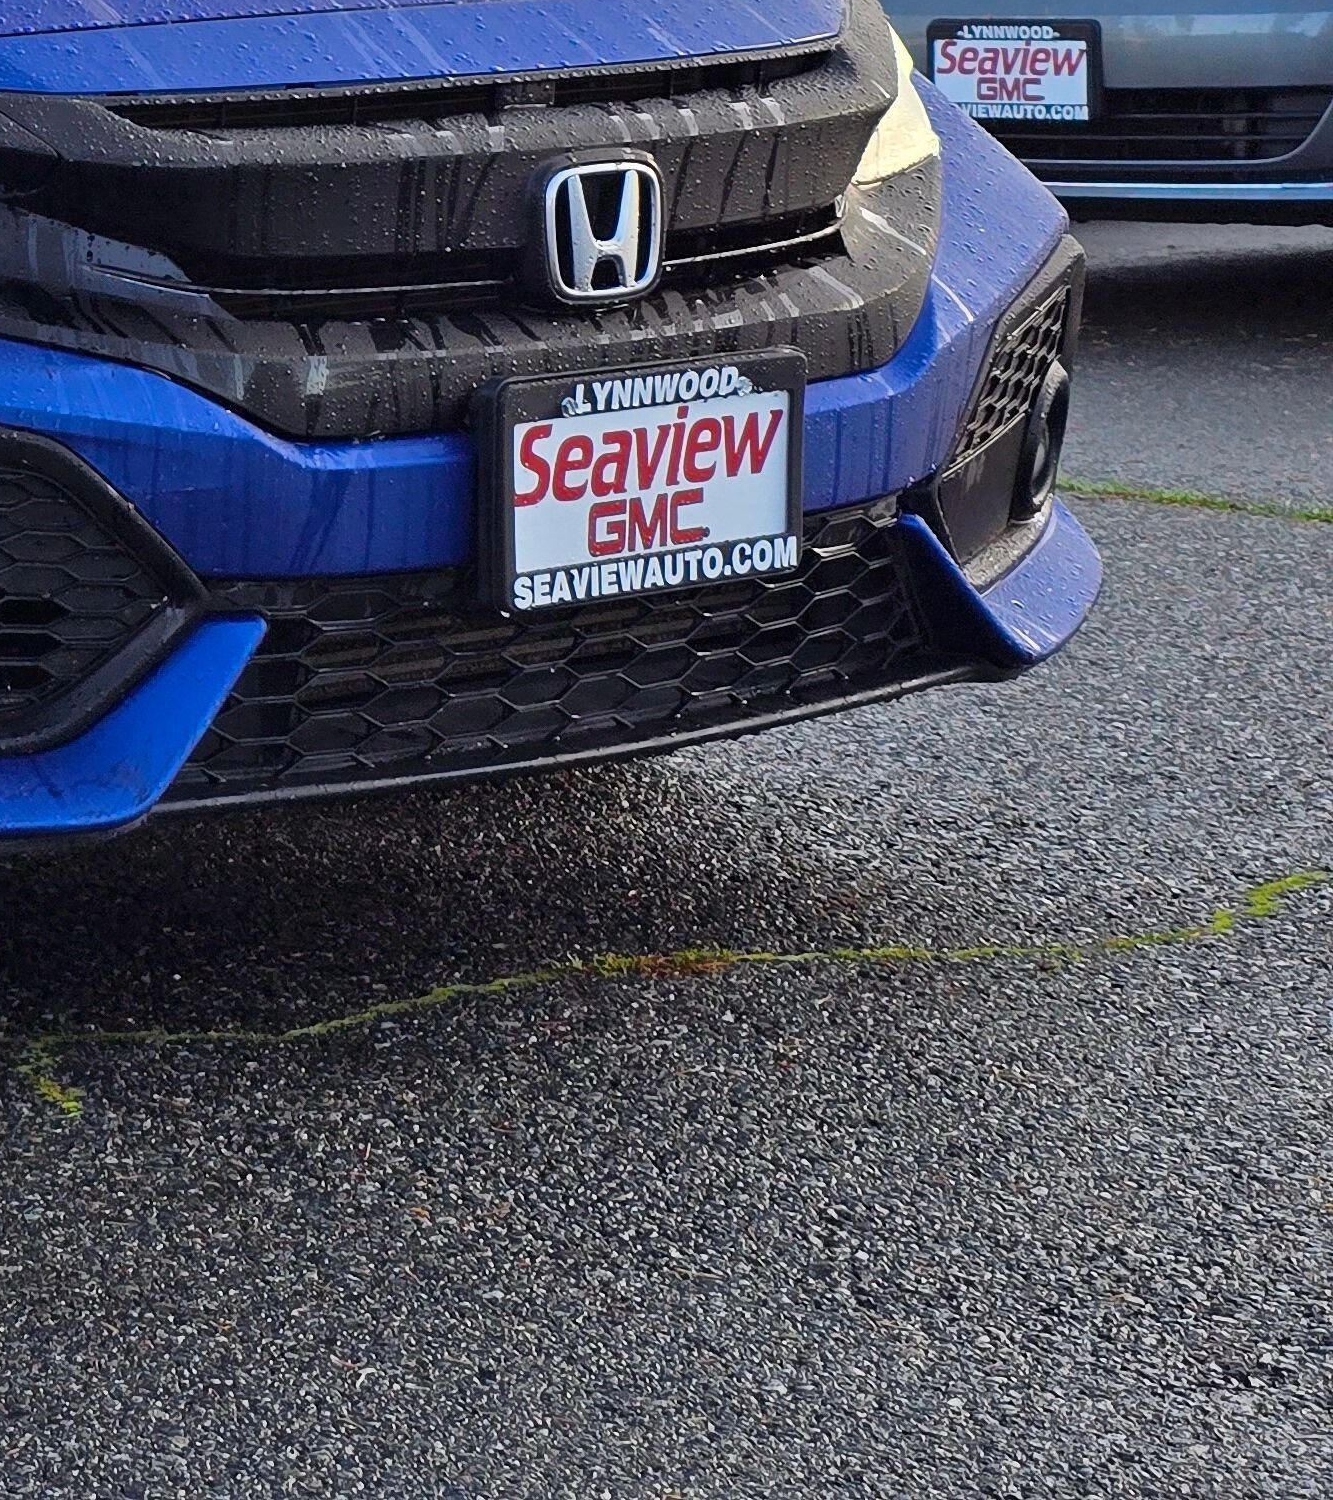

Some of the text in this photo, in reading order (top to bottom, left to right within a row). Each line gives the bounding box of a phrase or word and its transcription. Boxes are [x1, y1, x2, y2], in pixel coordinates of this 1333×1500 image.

[962, 25, 1054, 39] LYNNWOOD
[936, 39, 1088, 76] Seaview
[976, 77, 1046, 102] GMC
[959, 104, 1089, 121] VIEWAUTO.COM
[576, 366, 739, 412] LYNNWOOD
[513, 405, 784, 508] Seaview
[588, 488, 711, 557] GMC
[513, 535, 798, 611] SEAVIEWAUTO.COM
